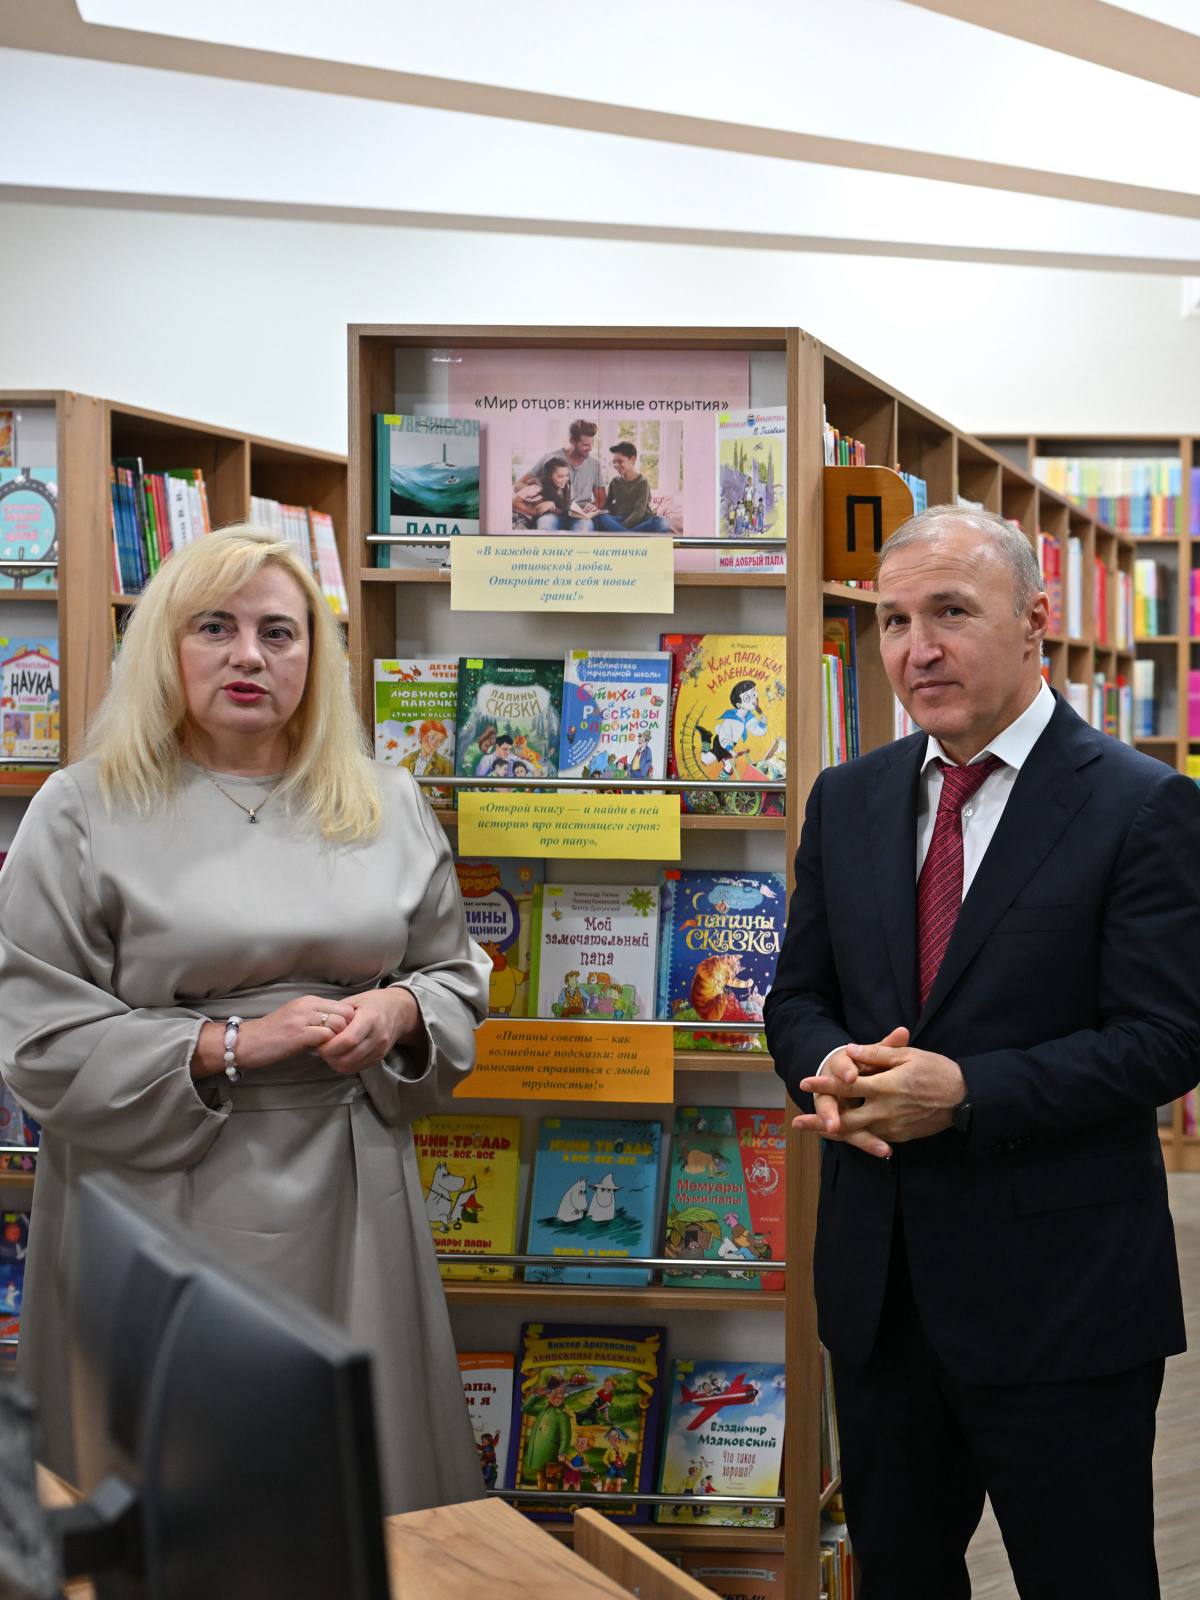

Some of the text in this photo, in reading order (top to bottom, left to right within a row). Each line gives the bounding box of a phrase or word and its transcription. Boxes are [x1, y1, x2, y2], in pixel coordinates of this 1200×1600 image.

[474, 395, 729, 412] «Мир отцов: книжные открытия»
[406, 522, 460, 536] ПАПА
[846, 496, 882, 552] П
[495, 546, 539, 556] каждой
[543, 548, 573, 557] книге
[593, 548, 647, 556] частичка
[511, 562, 572, 572] отцовской
[720, 555, 784, 567] МОЙ ДОБРЫЙ ПАПА
[489, 576, 550, 587] Откройте
[552, 576, 572, 586] для
[575, 576, 599, 586] себя
[540, 591, 584, 603] грани!»
[587, 661, 636, 670] Библиотека
[708, 652, 783, 673] КАК ПАПА БЫЛ
[586, 669, 631, 678] начальной
[11, 670, 53, 696] НАУКА
[707, 667, 770, 694] МАЛЕНЬКИМ
[491, 689, 537, 701] ПАПИНЫ
[576, 683, 636, 701] Стихи
[487, 699, 542, 718] СКАЗКИ
[602, 733, 636, 744] папе
[480, 803, 530, 814] «Открой
[534, 805, 565, 815] книгу
[593, 806, 627, 815] найди
[639, 806, 660, 815] ней
[478, 820, 660, 832] историю про настоящего героя:
[540, 838, 598, 847] про папу».
[584, 916, 612, 931] Мой
[468, 926, 507, 936] ЩНИКИ
[545, 932, 648, 948] замечательный
[686, 929, 781, 954] СКАЗКИ
[580, 951, 614, 966] папа
[496, 1031, 631, 1044] «Папины советы как
[488, 1048, 638, 1060] волшебные подсказки: они
[476, 1064, 534, 1074] помогают
[538, 1065, 602, 1076] справиться
[614, 1066, 650, 1076] любой
[521, 1079, 604, 1092] трудностью!»
[678, 1180, 744, 1194] Мемуары
[676, 1193, 742, 1205] Муми-папы
[464, 1240, 492, 1248] ПАПЫ
[464, 1382, 496, 1394] апа,
[710, 1422, 767, 1436] Владимир
[698, 1434, 776, 1448] Маяковский
[723, 1450, 756, 1464] Что такое
[722, 1464, 754, 1480] хорошо?
